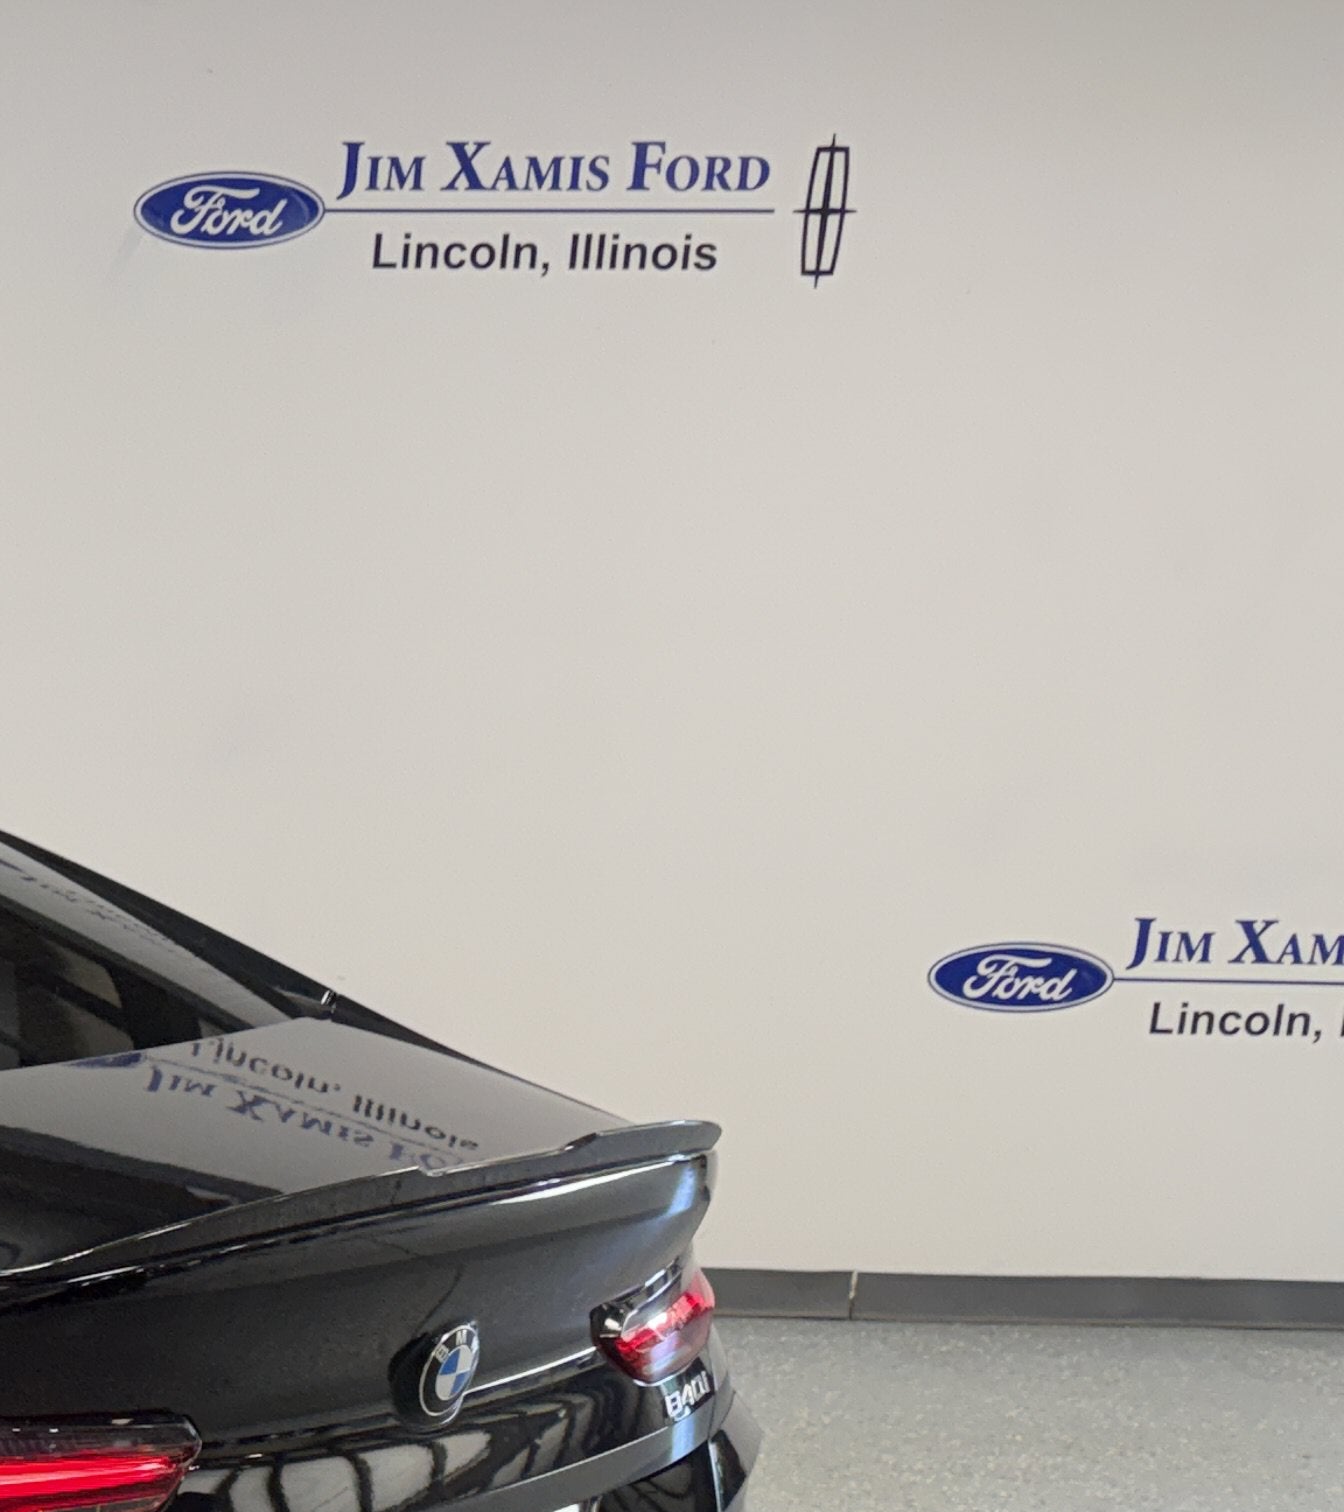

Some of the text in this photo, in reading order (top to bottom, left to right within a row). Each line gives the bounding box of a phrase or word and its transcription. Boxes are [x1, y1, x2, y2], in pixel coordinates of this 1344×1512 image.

[627, 141, 772, 192] FORD
[170, 183, 288, 235] Ford
[372, 231, 718, 276] Lincoln, Illinois
[962, 953, 1077, 1000] Ford
[1148, 1002, 1322, 1043] Lincoln,
